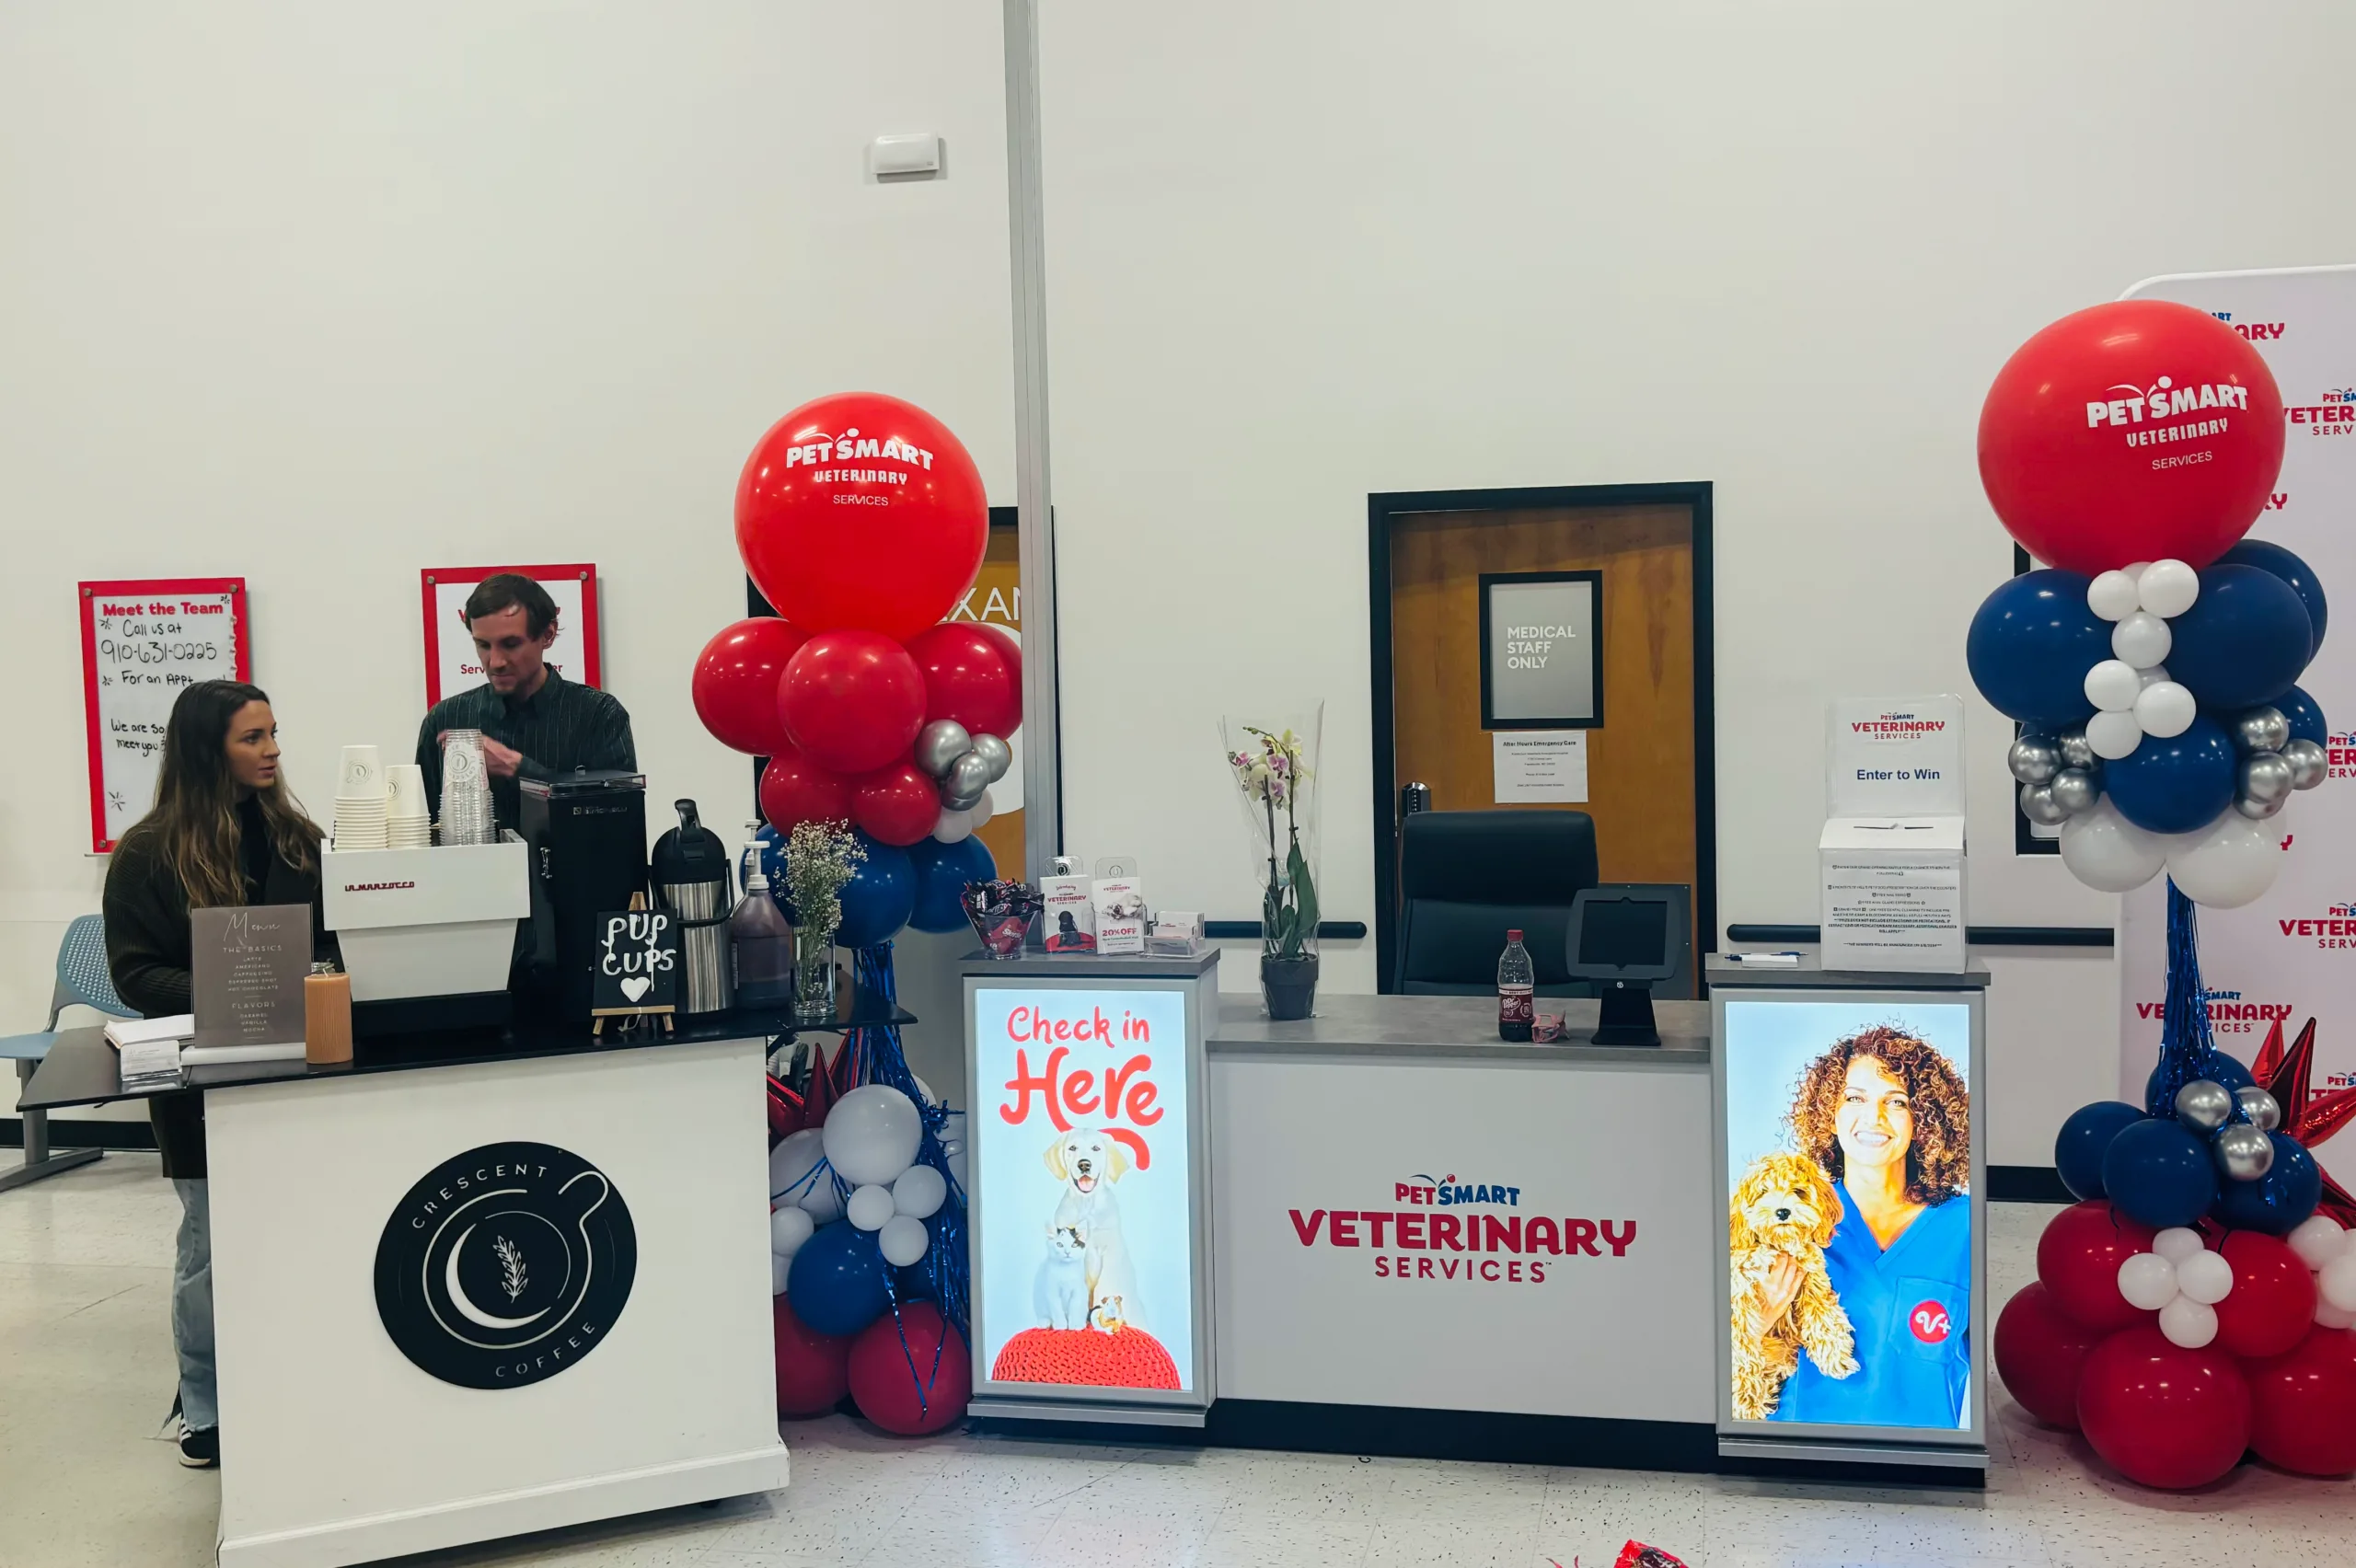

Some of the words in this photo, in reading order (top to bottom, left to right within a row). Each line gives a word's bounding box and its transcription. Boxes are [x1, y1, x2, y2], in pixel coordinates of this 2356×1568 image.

[2086, 381, 2248, 428] PETSMART
[2125, 418, 2229, 448] VETERINARY
[786, 436, 934, 471] PETSMART
[2151, 451, 2213, 471] SERVICES
[814, 468, 907, 486] VETERINARY
[833, 494, 889, 506] SERVICES
[102, 603, 144, 617] Meet
[149, 603, 176, 616] the
[180, 602, 224, 615] Team
[122, 619, 147, 637] Call
[151, 623, 164, 635] us
[168, 623, 182, 633] at
[1507, 626, 1576, 640] MEDICAL
[101, 640, 217, 663] 910-631-0225
[1507, 641, 1552, 654] STAFF
[1507, 656, 1548, 669] ONLY
[121, 670, 144, 685] For
[146, 675, 161, 684] an
[110, 718, 128, 732] We
[132, 723, 147, 732] are
[1852, 721, 1945, 732] VETERINARY
[142, 742, 158, 757] you
[1856, 769, 1893, 780] Enter
[1897, 770, 1911, 780] to
[1914, 768, 1940, 780] Win
[224, 912, 281, 942] Menu
[601, 914, 668, 948] PUP
[248, 944, 283, 952] BASICS
[602, 949, 676, 977] CUPS
[232, 1001, 276, 1009] FLAVORS
[1007, 1006, 1114, 1048] Check
[1123, 1010, 1150, 1043] in
[999, 1046, 1164, 1155] Here
[412, 1164, 548, 1229] CRESCENT
[1394, 1178, 1520, 1206] PETSMART
[1288, 1209, 1636, 1257] VETERINARY
[495, 1321, 595, 1378] COFFEE
